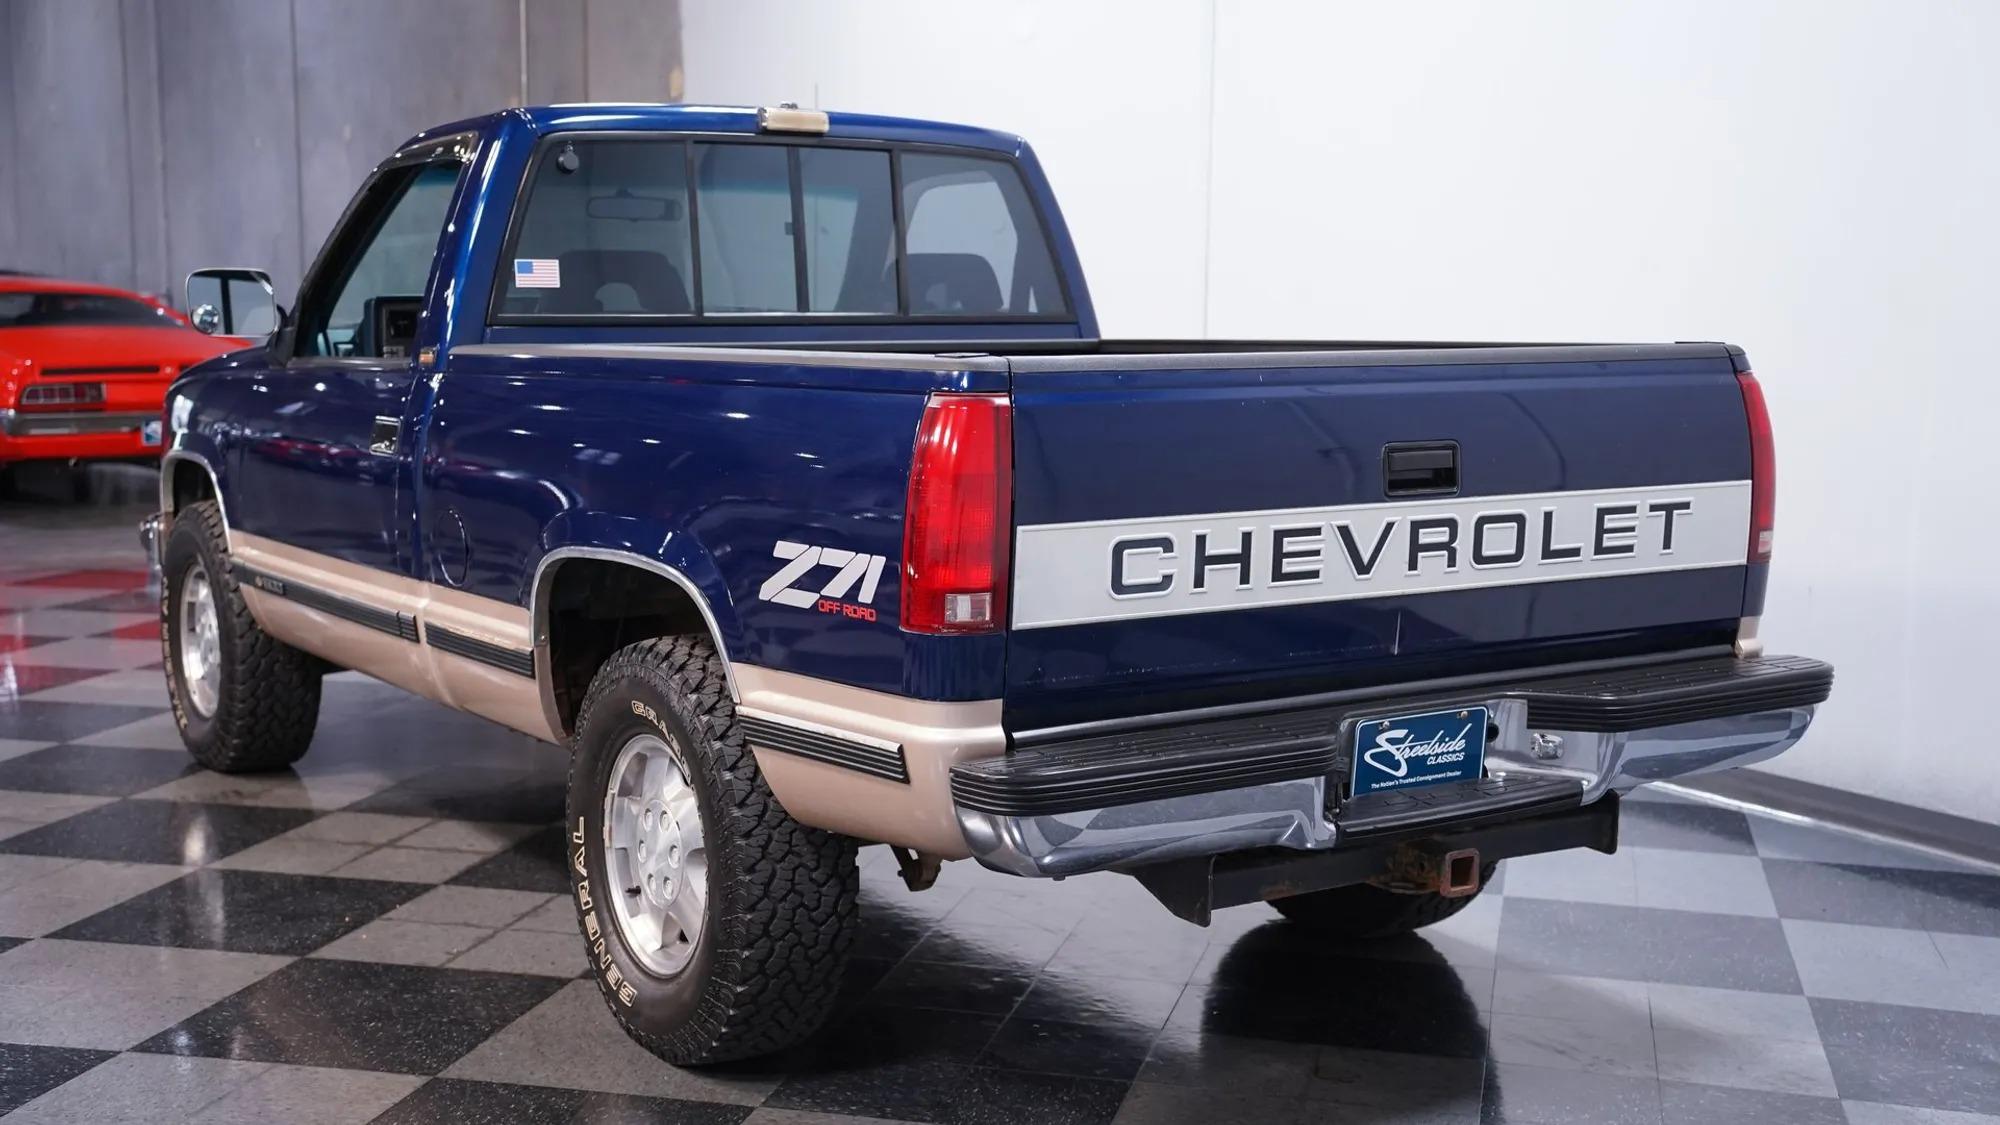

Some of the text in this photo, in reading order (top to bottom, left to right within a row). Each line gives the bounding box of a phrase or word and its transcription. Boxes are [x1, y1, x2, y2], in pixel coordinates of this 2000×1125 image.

[759, 540, 887, 609] Z71
[1110, 499, 1694, 598] CHEVROLET
[818, 599, 878, 621] OFF ROAD
[1364, 723, 1472, 777] Streetside
[1426, 752, 1465, 765] CLASSICS
[1380, 779, 1399, 788] Nation's
[1399, 777, 1416, 785] Trusted
[573, 816, 638, 1008] GENERAL
